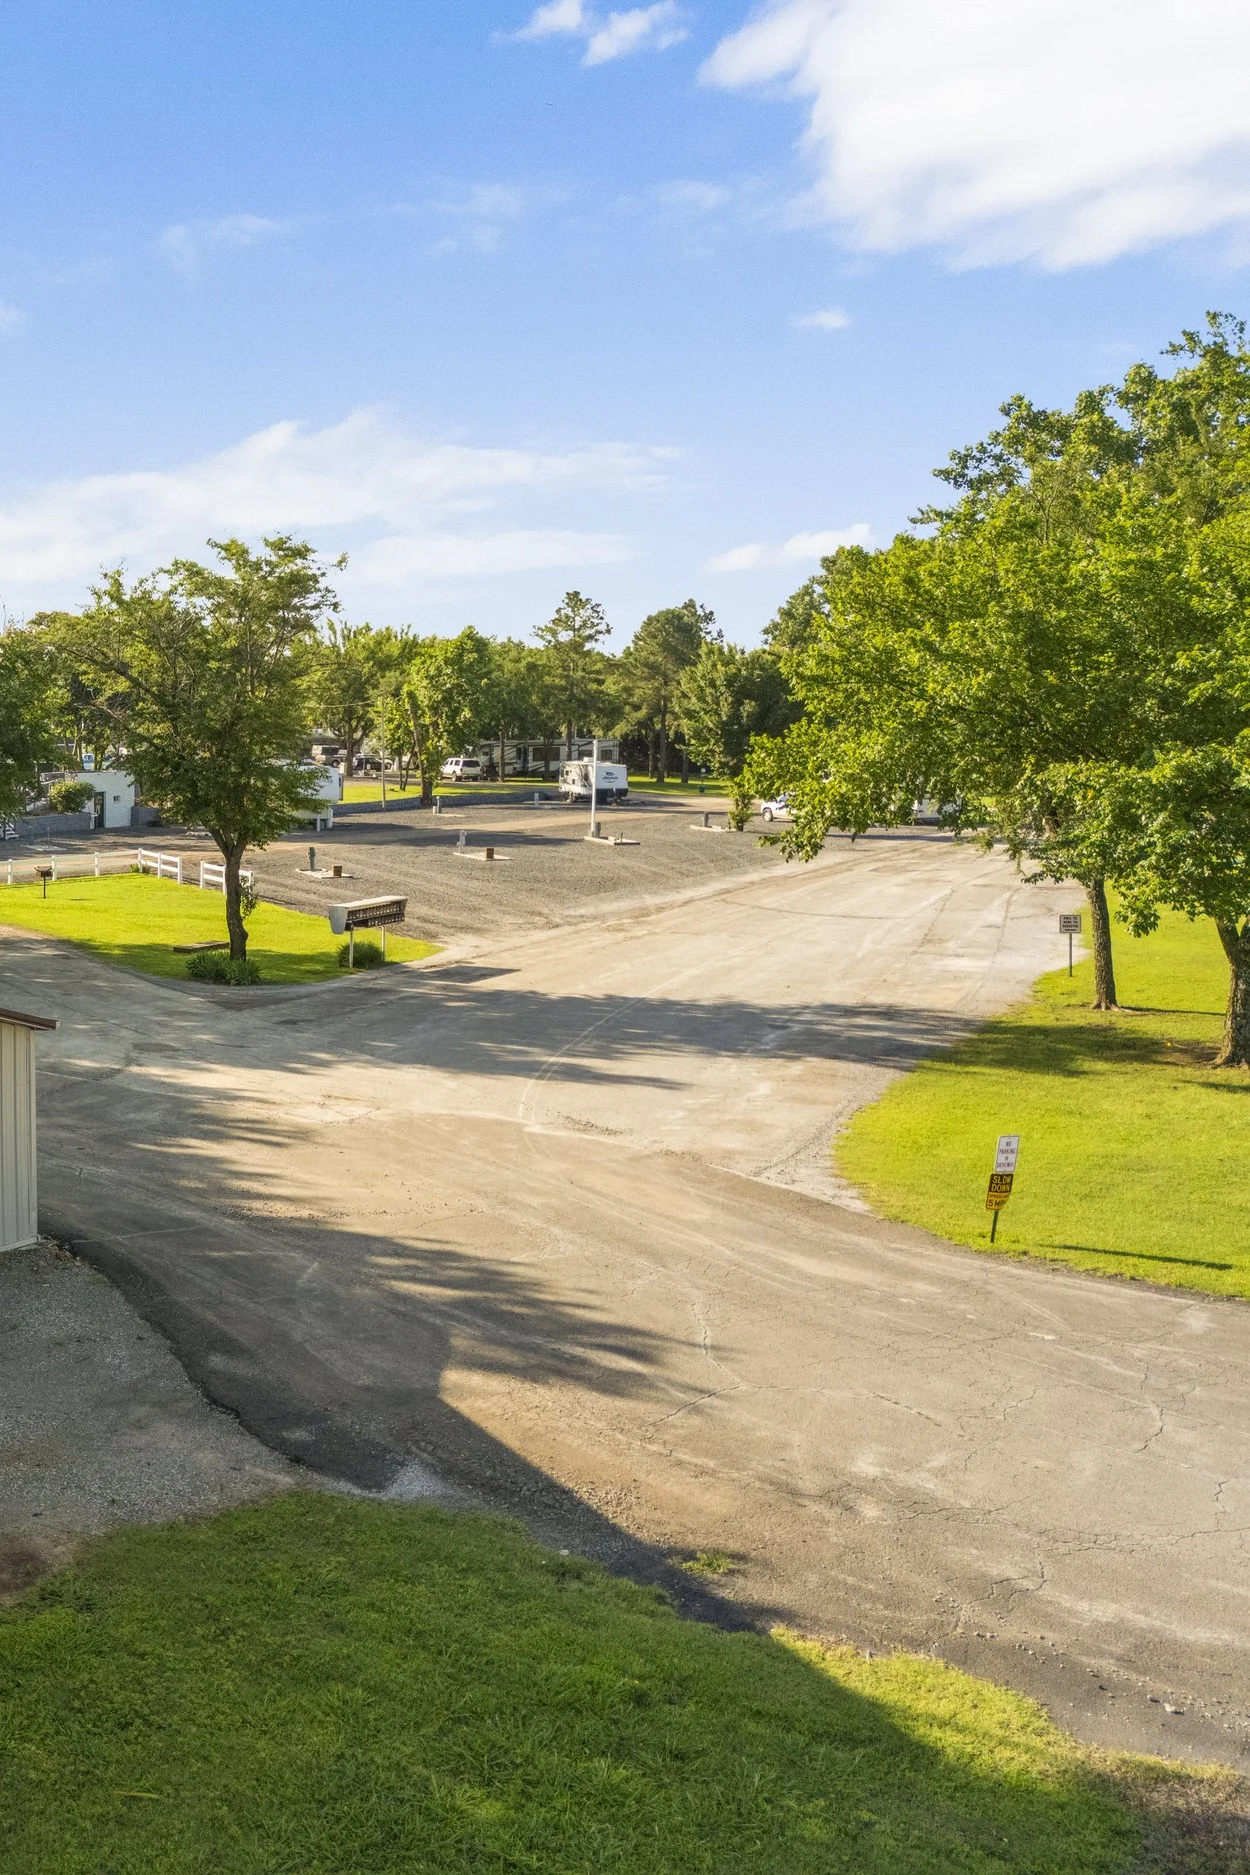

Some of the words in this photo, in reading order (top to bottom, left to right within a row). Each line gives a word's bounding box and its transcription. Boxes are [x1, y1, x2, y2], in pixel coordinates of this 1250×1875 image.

[992, 1175, 1012, 1184] SLOW
[991, 1183, 1011, 1192] DOWN
[988, 1199, 994, 1207] 5
